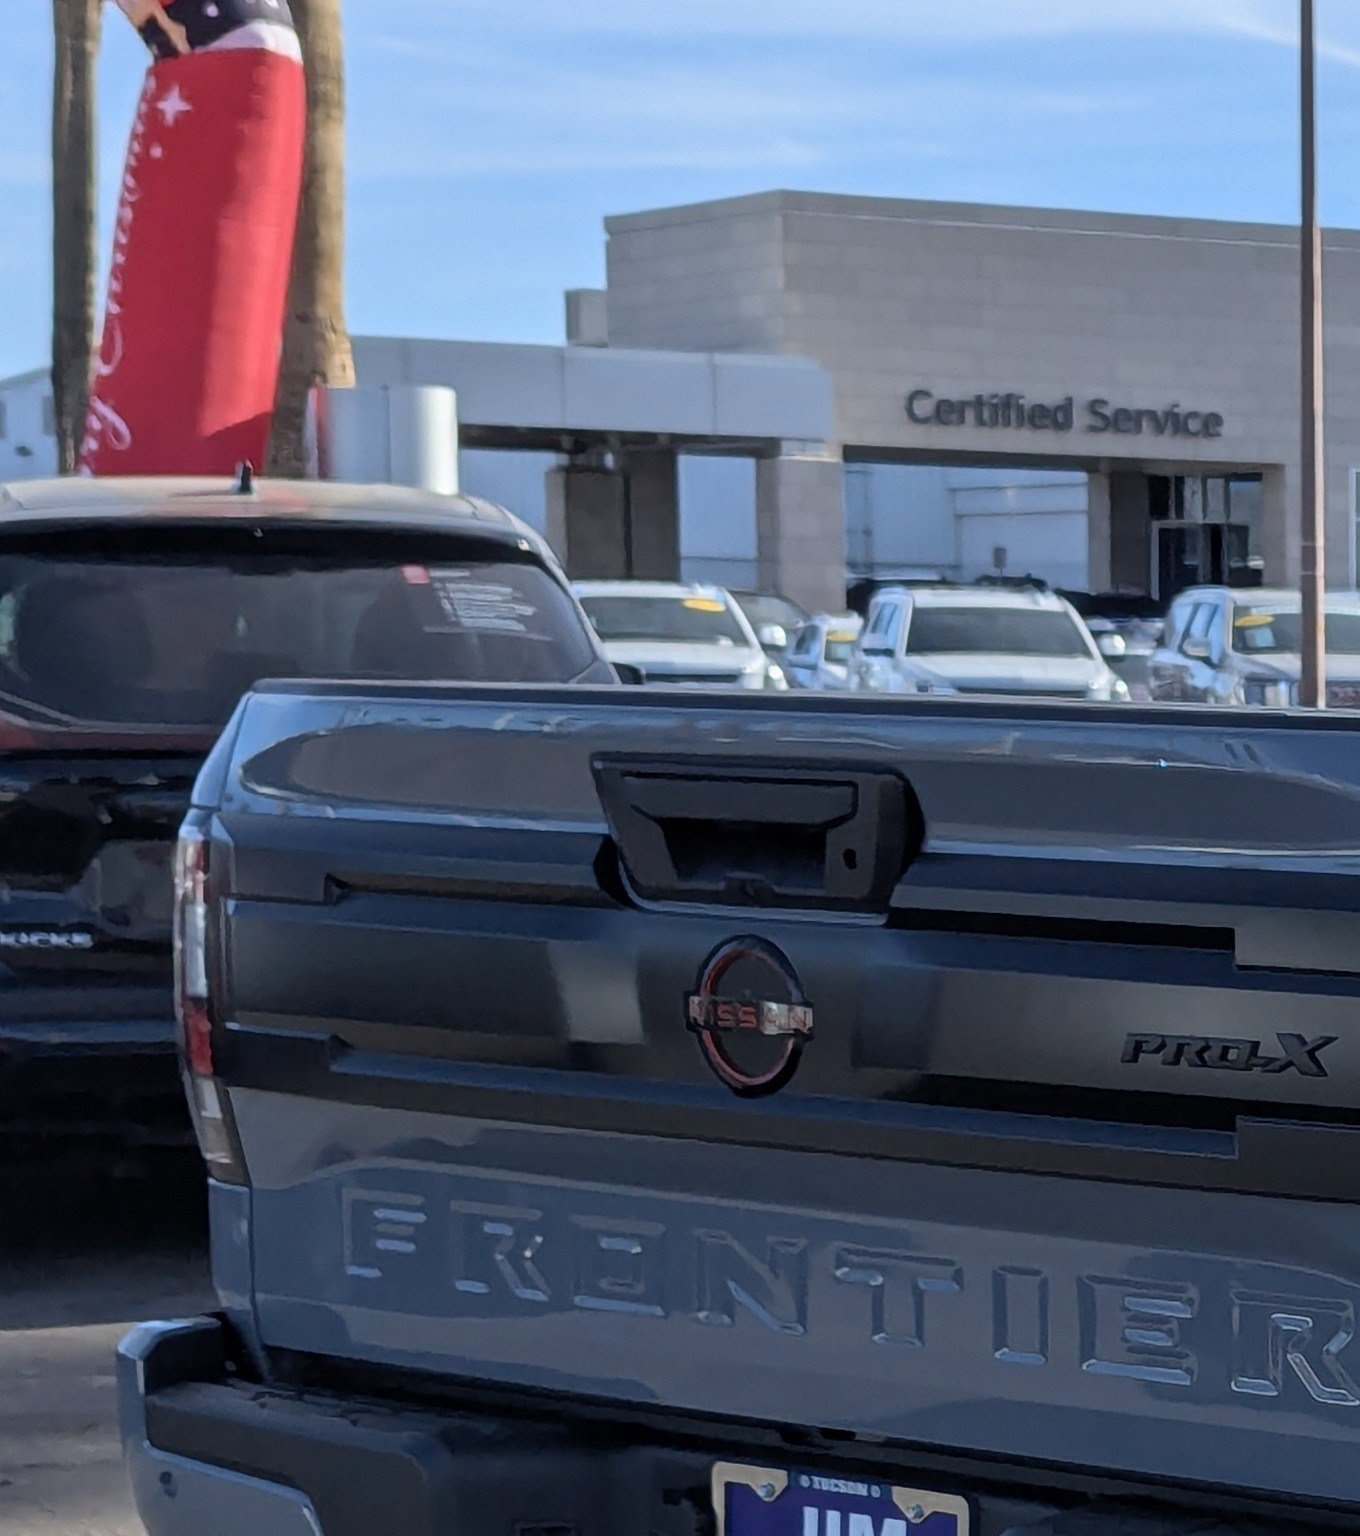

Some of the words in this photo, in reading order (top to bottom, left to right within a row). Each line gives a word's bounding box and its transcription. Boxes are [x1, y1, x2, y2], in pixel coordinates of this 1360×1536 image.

[904, 389, 1074, 432] Certified
[1086, 398, 1225, 438] Service
[689, 995, 814, 1035] NISSAN
